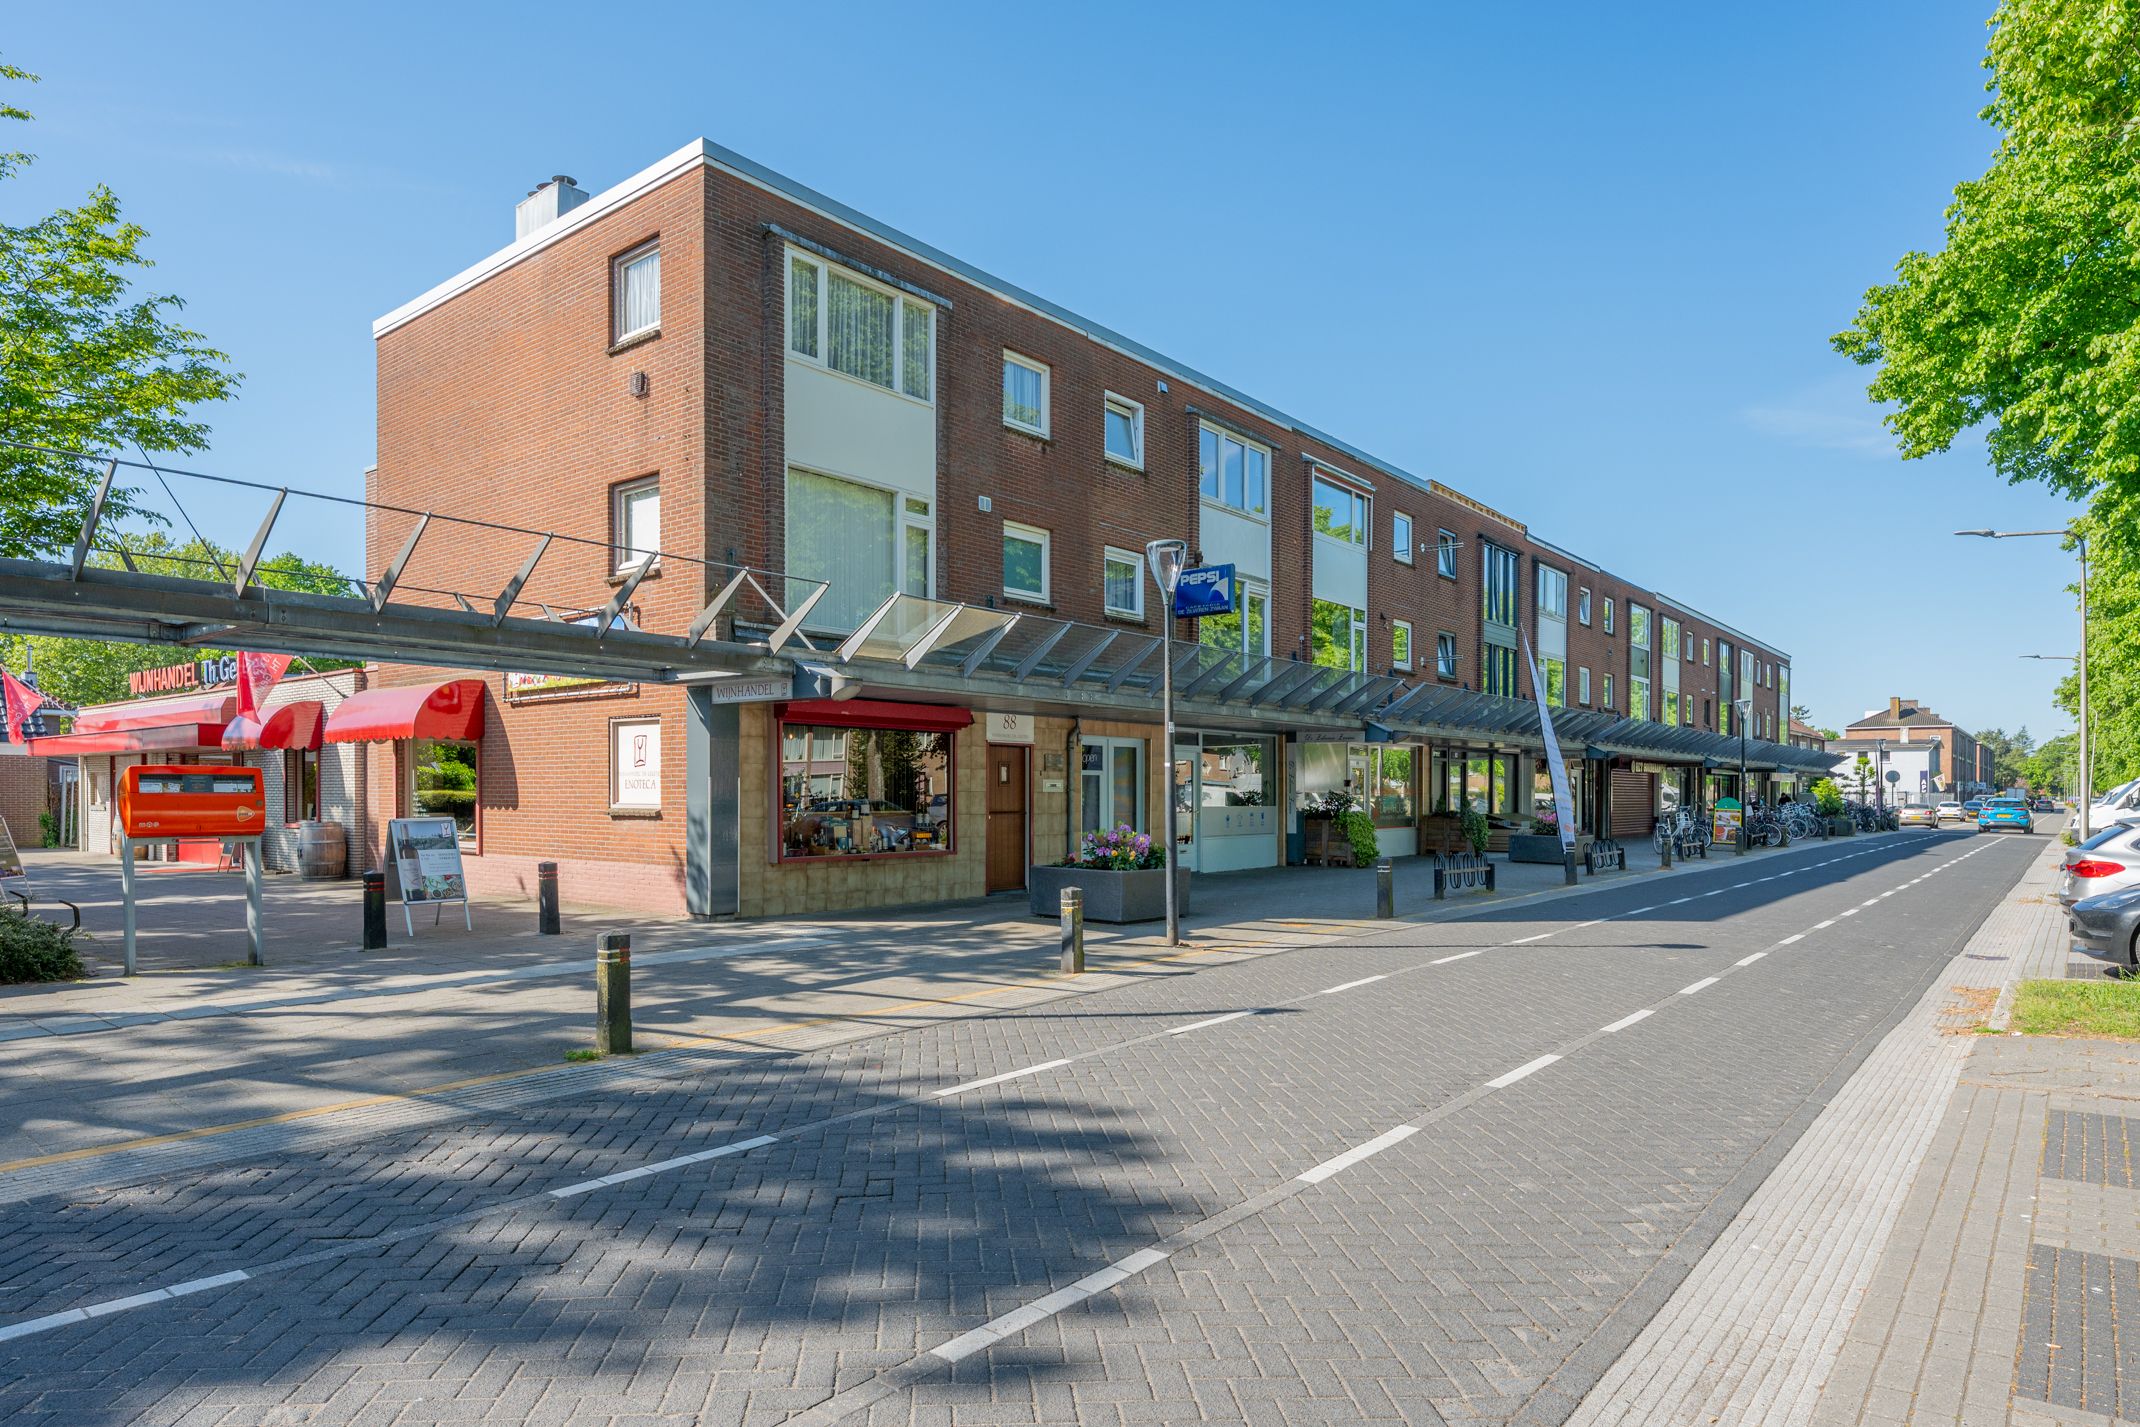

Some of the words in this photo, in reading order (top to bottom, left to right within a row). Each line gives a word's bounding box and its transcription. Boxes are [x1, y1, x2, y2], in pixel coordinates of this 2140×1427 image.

[1180, 570, 1219, 586] PEPSI
[129, 662, 199, 694] WIJNHANDEL
[716, 683, 774, 700] WIJNHANDEL
[1003, 714, 1017, 729] 88
[624, 779, 656, 790] ENOTECA
